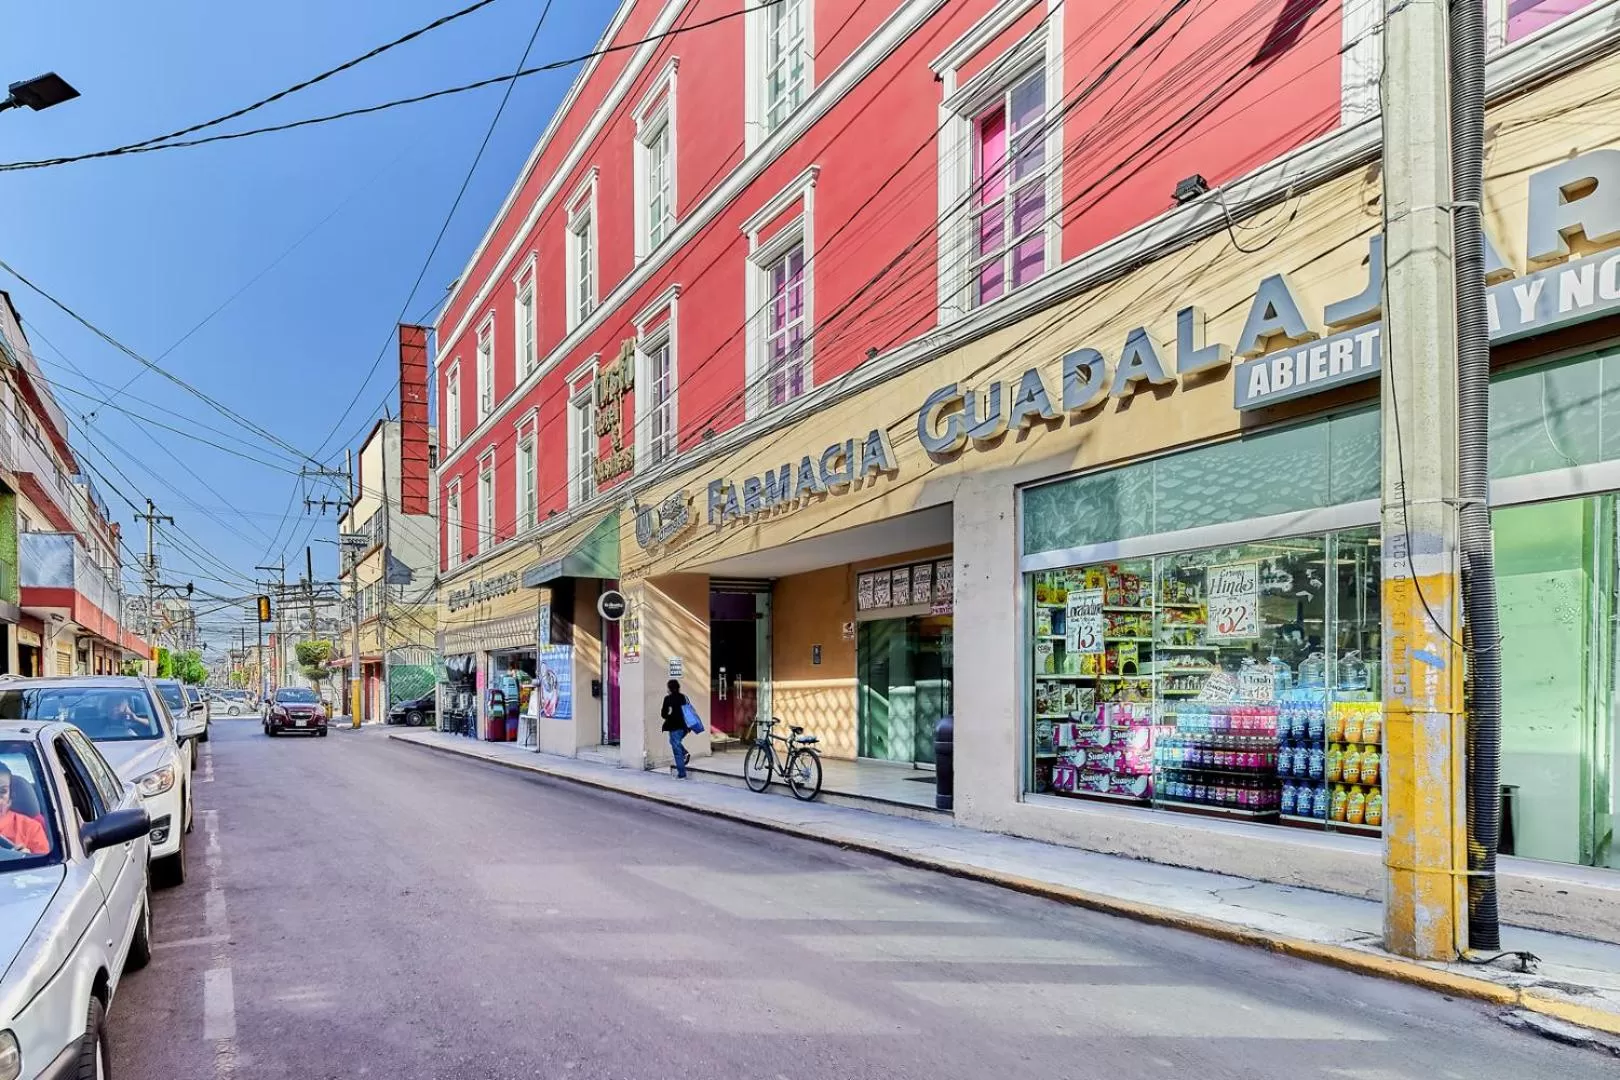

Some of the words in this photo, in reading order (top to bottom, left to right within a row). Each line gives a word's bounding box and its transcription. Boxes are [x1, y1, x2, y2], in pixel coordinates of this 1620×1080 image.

[1247, 327, 1382, 400] ABIERT
[1513, 277, 1546, 324] Y
[708, 429, 897, 525] FARMACIA
[1209, 576, 1254, 595] Hinds
